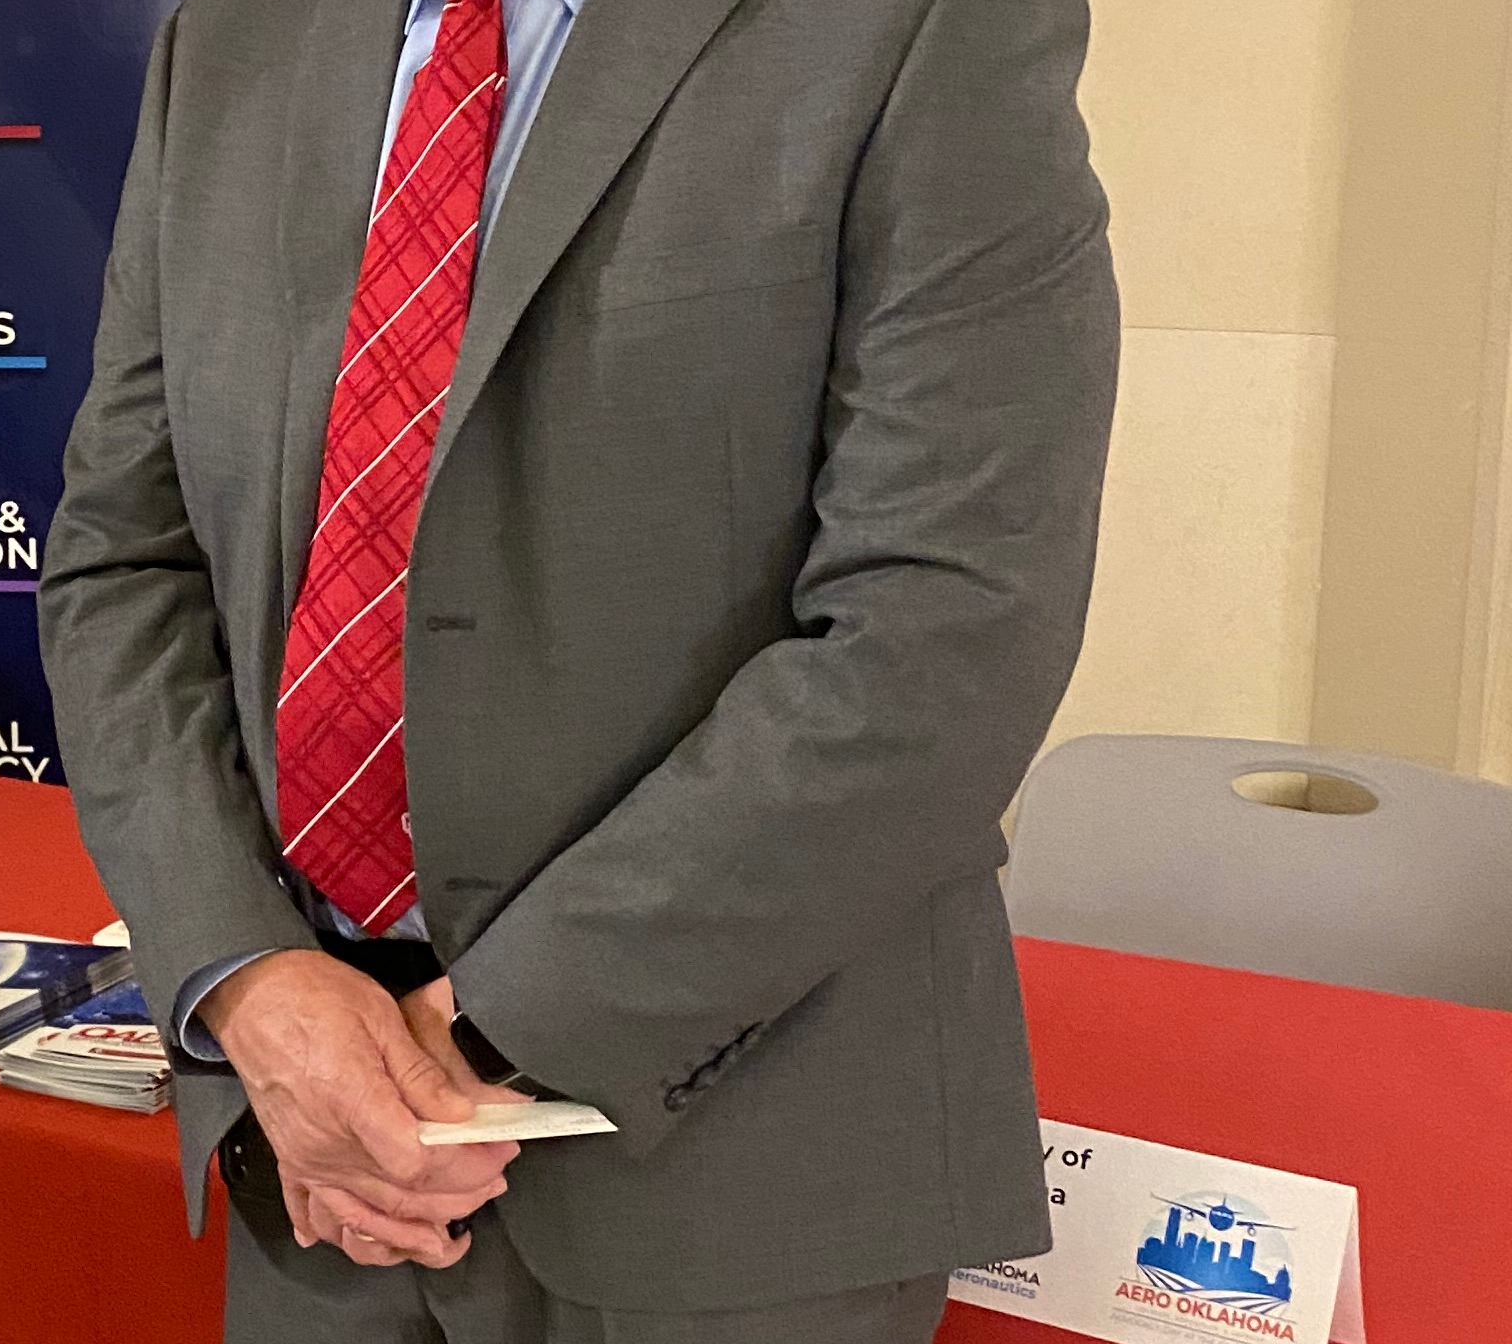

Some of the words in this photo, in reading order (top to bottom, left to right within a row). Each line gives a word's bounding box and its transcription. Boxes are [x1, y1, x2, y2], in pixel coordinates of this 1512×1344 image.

[1061, 1148, 1094, 1170] of
[950, 1268, 1037, 1300] eronautics
[1114, 1281, 1171, 1309] AERO
[1176, 1297, 1295, 1342] OKLAHOMA
